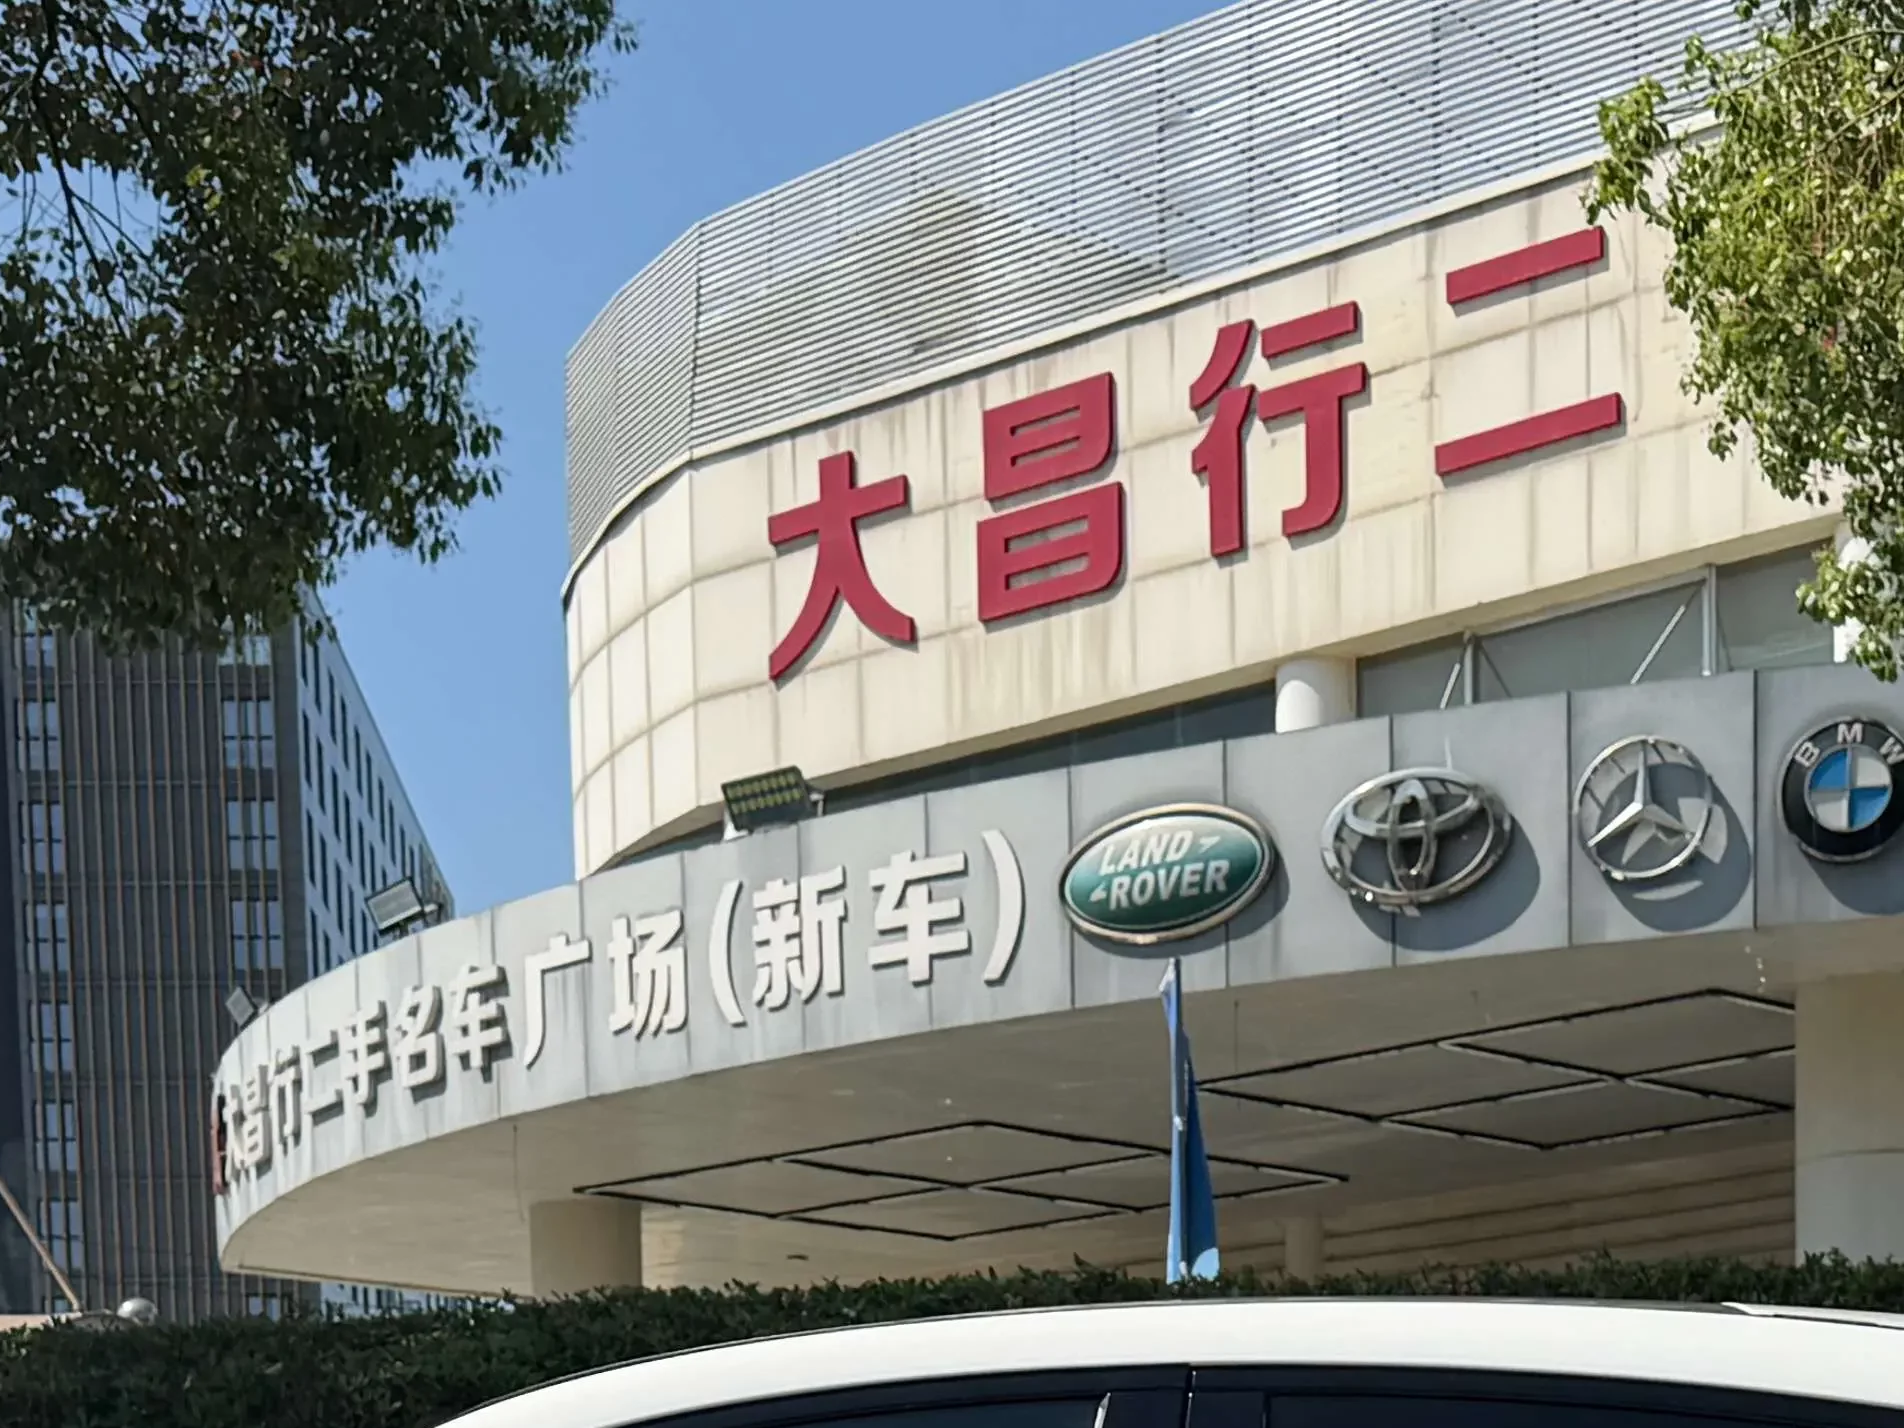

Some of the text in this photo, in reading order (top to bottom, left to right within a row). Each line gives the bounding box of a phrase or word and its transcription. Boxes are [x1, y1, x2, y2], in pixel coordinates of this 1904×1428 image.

[767, 224, 1626, 680] 大昌行二
[1099, 829, 1194, 877] LAND
[1109, 859, 1231, 911] ROVER
